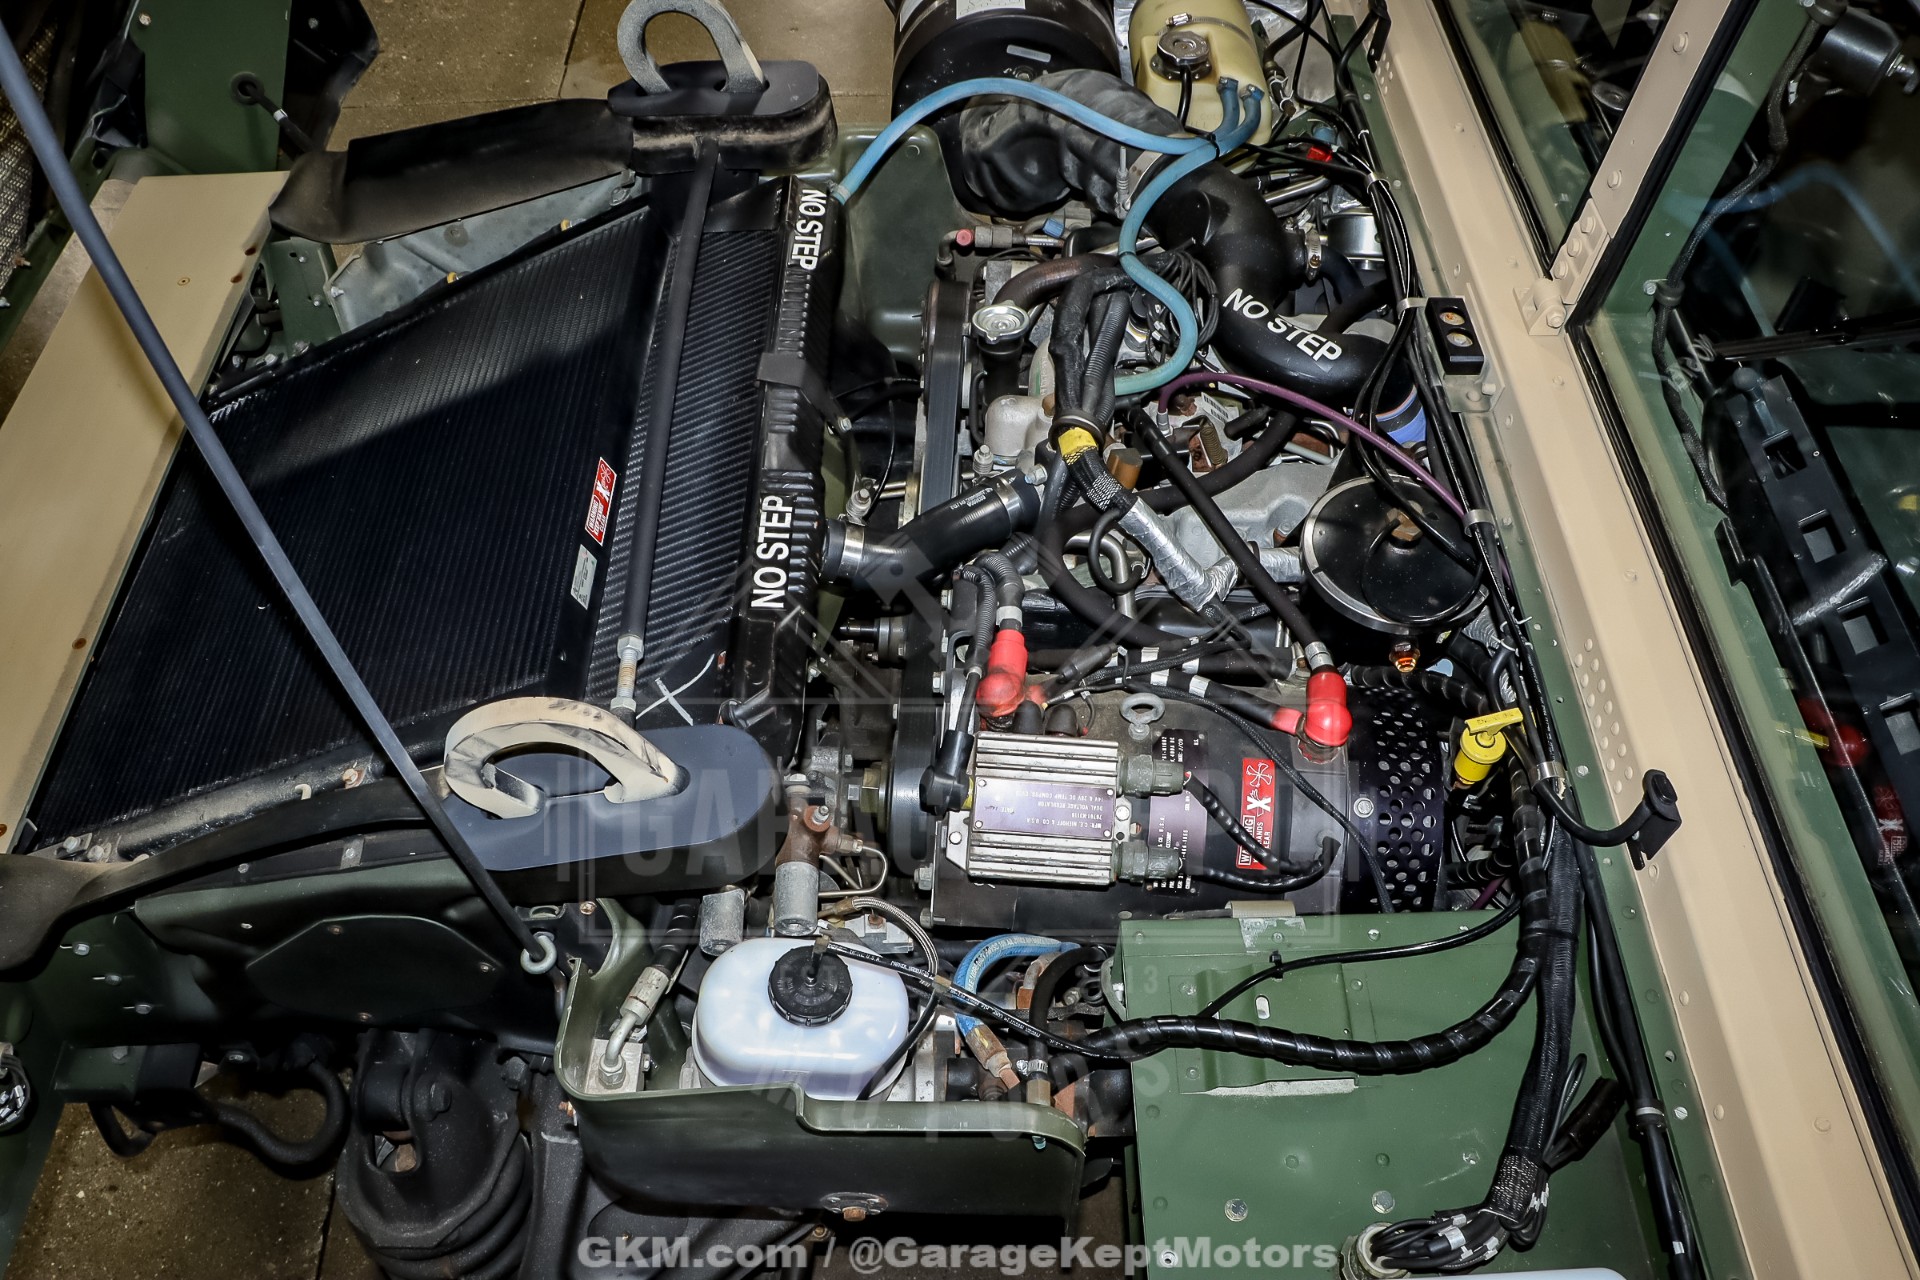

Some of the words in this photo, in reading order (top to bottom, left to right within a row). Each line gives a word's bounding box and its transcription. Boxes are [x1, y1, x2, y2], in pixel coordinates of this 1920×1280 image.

[799, 189, 827, 217] NO
[791, 219, 824, 271] STEP
[1222, 287, 1270, 319] NO
[1266, 317, 1343, 362] STEP
[587, 498, 599, 529] WARNING
[755, 495, 793, 560] STEP
[750, 566, 787, 608] NO
[1037, 800, 1066, 809] REGULATOR
[1067, 802, 1089, 811] VOLTAGE
